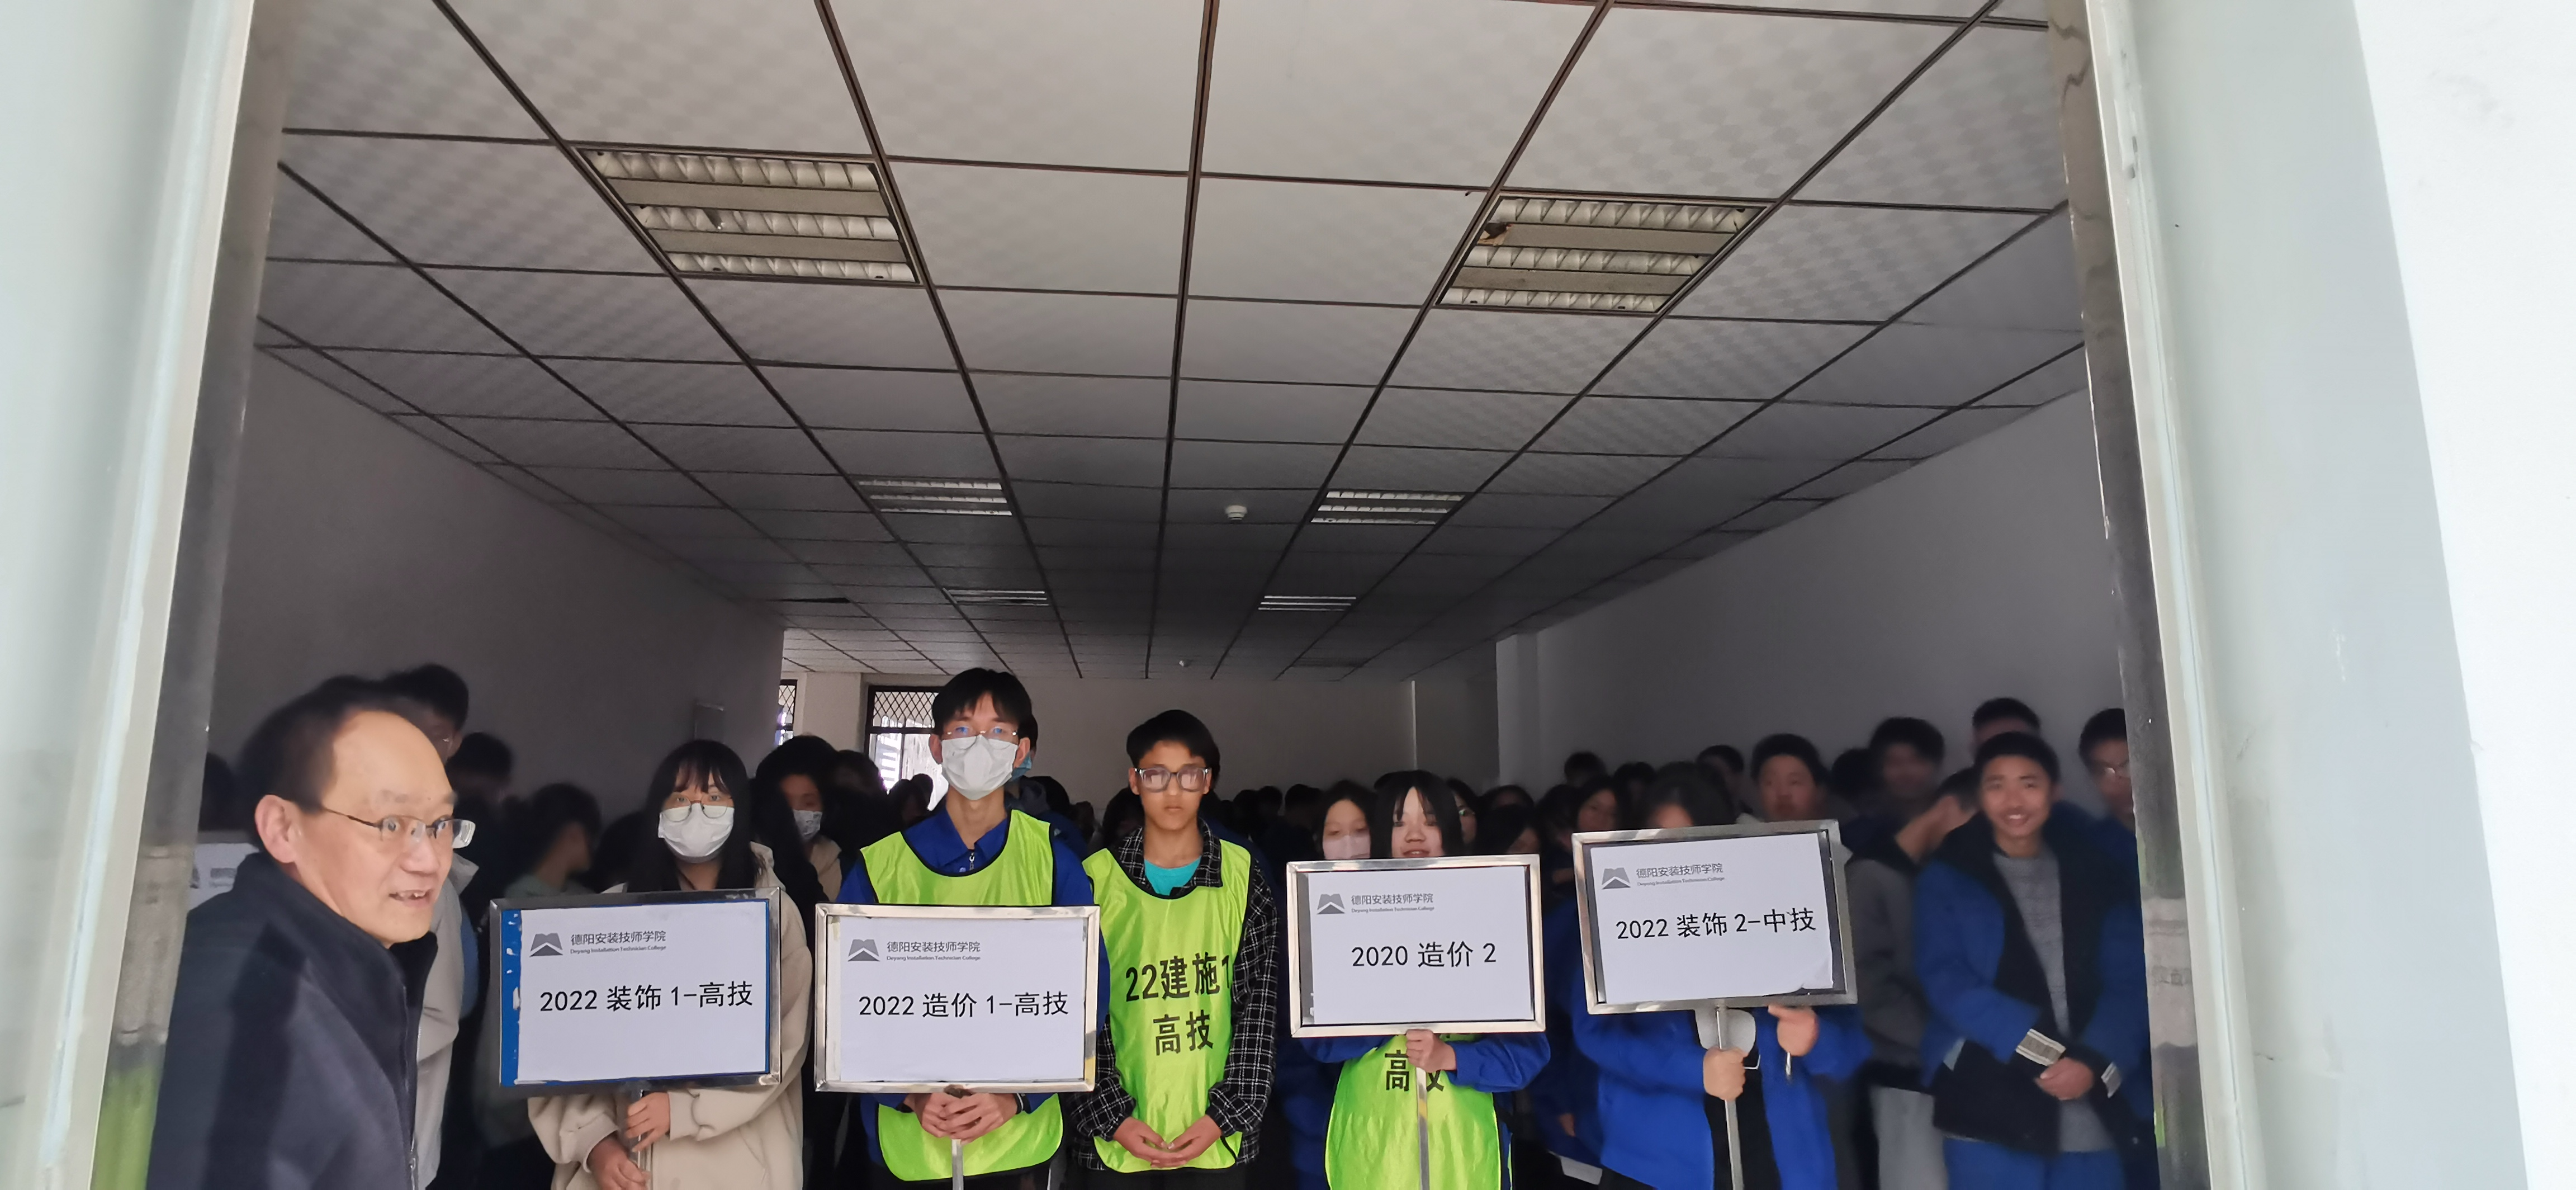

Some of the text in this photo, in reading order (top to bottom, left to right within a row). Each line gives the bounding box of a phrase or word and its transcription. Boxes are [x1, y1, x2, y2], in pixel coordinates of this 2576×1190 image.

[1636, 863, 1724, 879] 德阳安装技师学院
[1351, 893, 1434, 905] 德阳安装技师学院
[1616, 906, 1817, 939] 2022 装饰 2-中技
[570, 930, 667, 946] 德阳安装技师学院
[887, 941, 981, 952] 德阳安装技师学院
[1351, 941, 1497, 968] 2020 造价 2
[1125, 951, 1230, 1002] 22建施1
[539, 980, 753, 1012] 2022 装饰 1-高技
[859, 990, 1069, 1018] 2022 造价 1-高技
[1153, 1009, 1214, 1056] 高技
